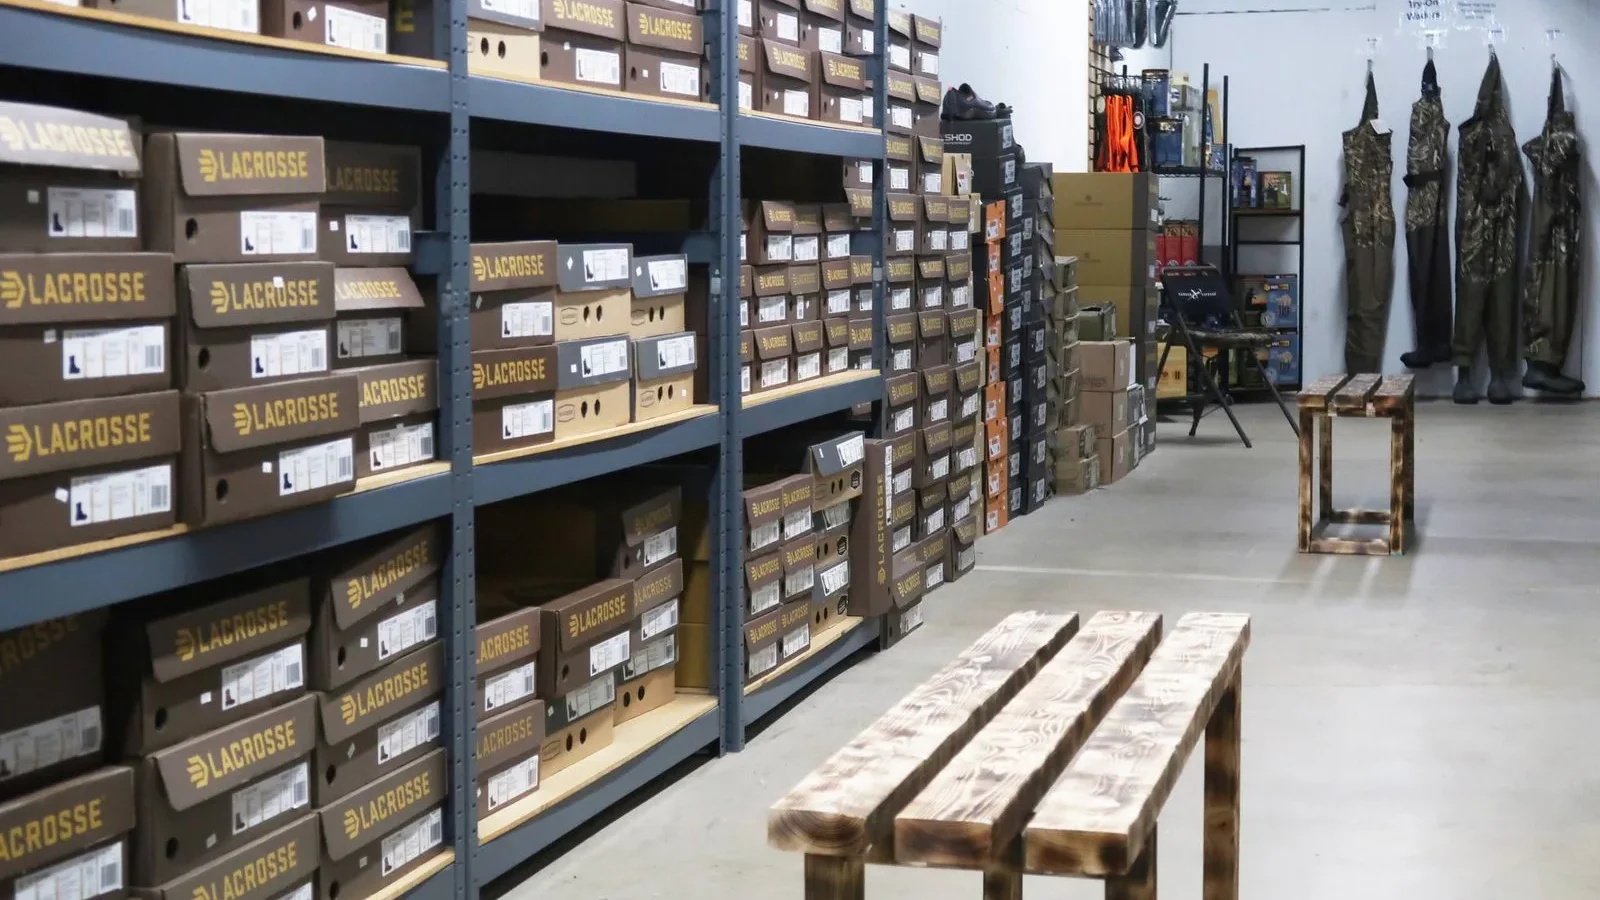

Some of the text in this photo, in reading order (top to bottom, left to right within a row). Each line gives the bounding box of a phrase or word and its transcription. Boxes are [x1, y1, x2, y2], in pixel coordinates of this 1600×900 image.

[564, 0, 615, 28] LACROSSE
[649, 16, 693, 41] LACROSSE
[17, 119, 130, 157] LACROSSE
[218, 150, 309, 179] LACROSSE
[326, 166, 399, 192] LACROSSE
[486, 253, 545, 280] LACROSSE
[28, 271, 146, 306] LACROSSE
[231, 279, 320, 310] LACROSSE
[336, 280, 402, 300] LACROSSE
[486, 358, 546, 387] LACROSSE
[359, 375, 425, 408] ACROSSE
[252, 392, 340, 431] LACROSSE
[34, 412, 152, 457] LACROSSE
[362, 541, 429, 597] LACROSSE
[198, 602, 289, 654] LACROSSE
[579, 594, 627, 630] LACROSSE
[476, 624, 530, 665] ACROSSE
[357, 662, 429, 717] LACROSSE
[207, 720, 297, 779] LACROSSE
[361, 771, 431, 829] LACROSSE
